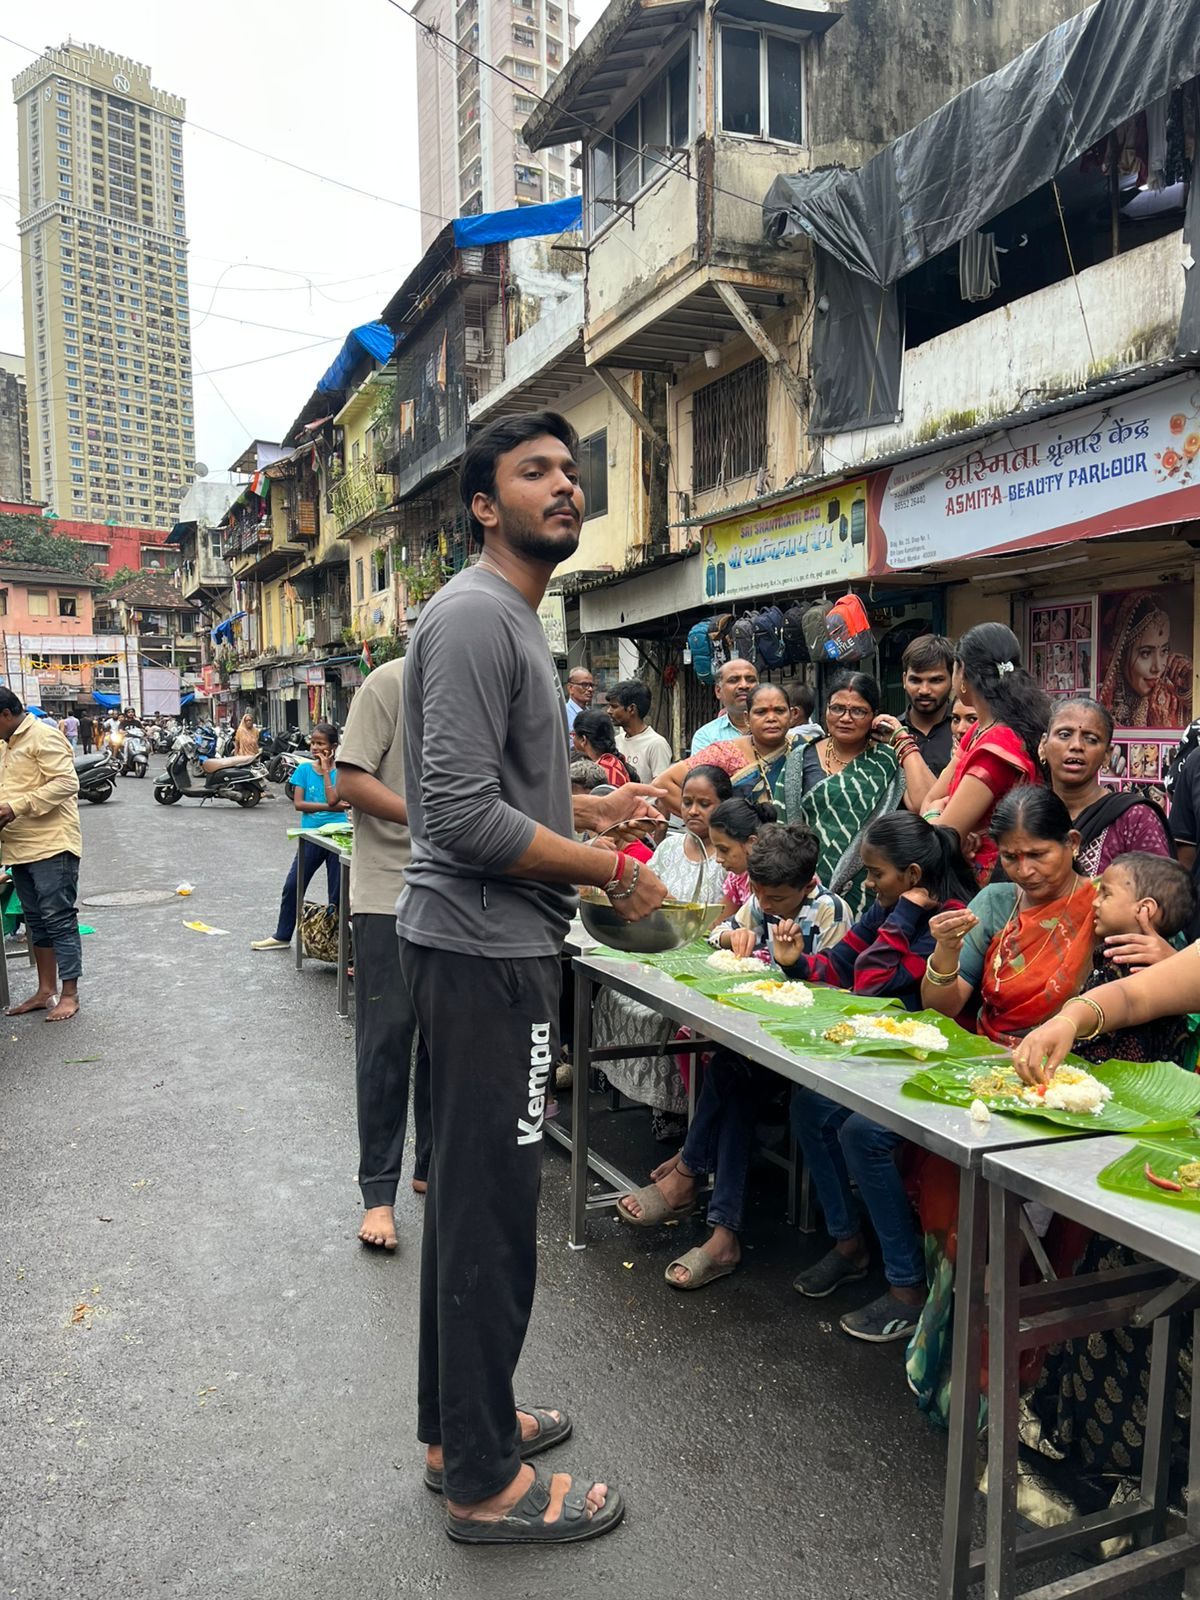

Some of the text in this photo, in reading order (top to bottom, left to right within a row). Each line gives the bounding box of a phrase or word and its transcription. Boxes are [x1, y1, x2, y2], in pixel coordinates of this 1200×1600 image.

[945, 443, 1040, 490] अस्मिता
[945, 485, 1002, 517] ASMITA
[1008, 472, 1064, 502] BEAUTY
[1069, 452, 1149, 488] PARLOUR
[804, 506, 821, 522] BAG
[517, 1022, 552, 1145] Kempa
